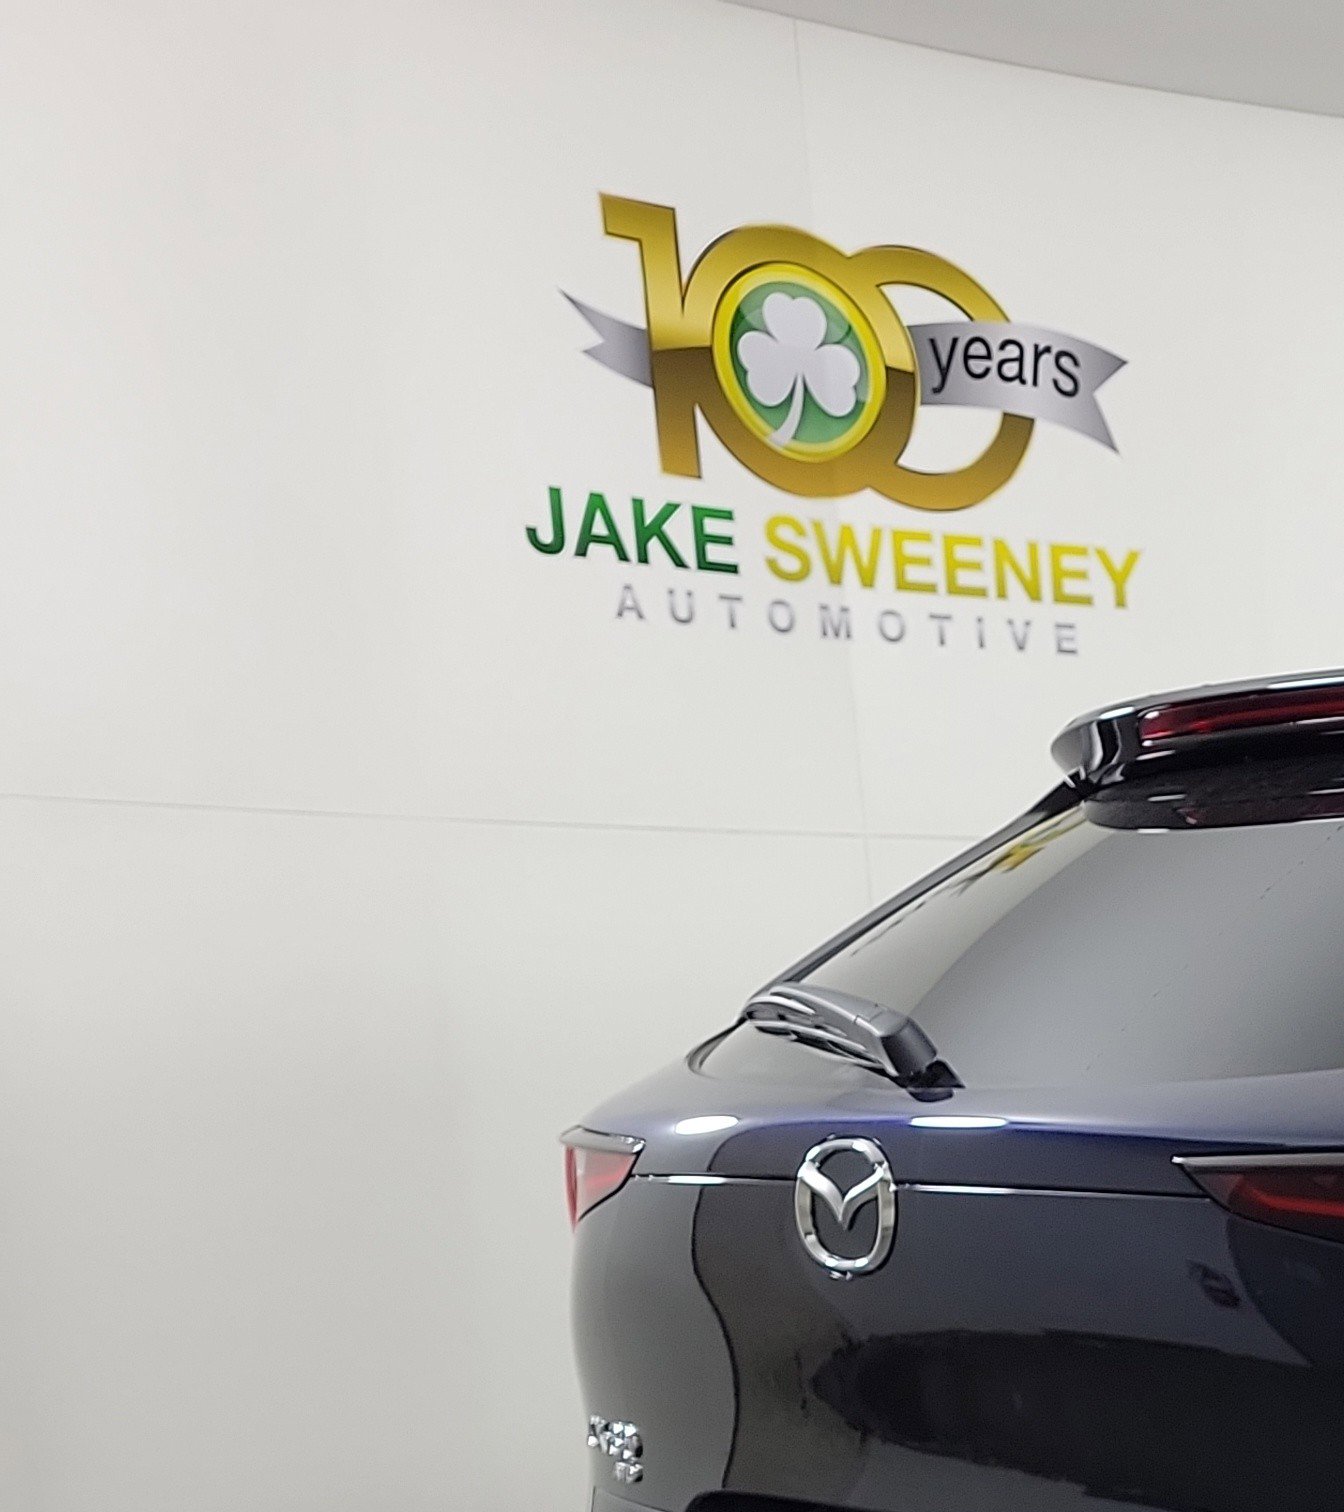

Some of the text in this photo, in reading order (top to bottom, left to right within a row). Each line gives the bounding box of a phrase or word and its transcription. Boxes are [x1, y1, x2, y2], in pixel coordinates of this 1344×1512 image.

[598, 192, 1081, 512] 100 years
[526, 486, 1141, 609] JAKE SWEENEY
[616, 583, 1080, 655] AUTOMOTIVE
